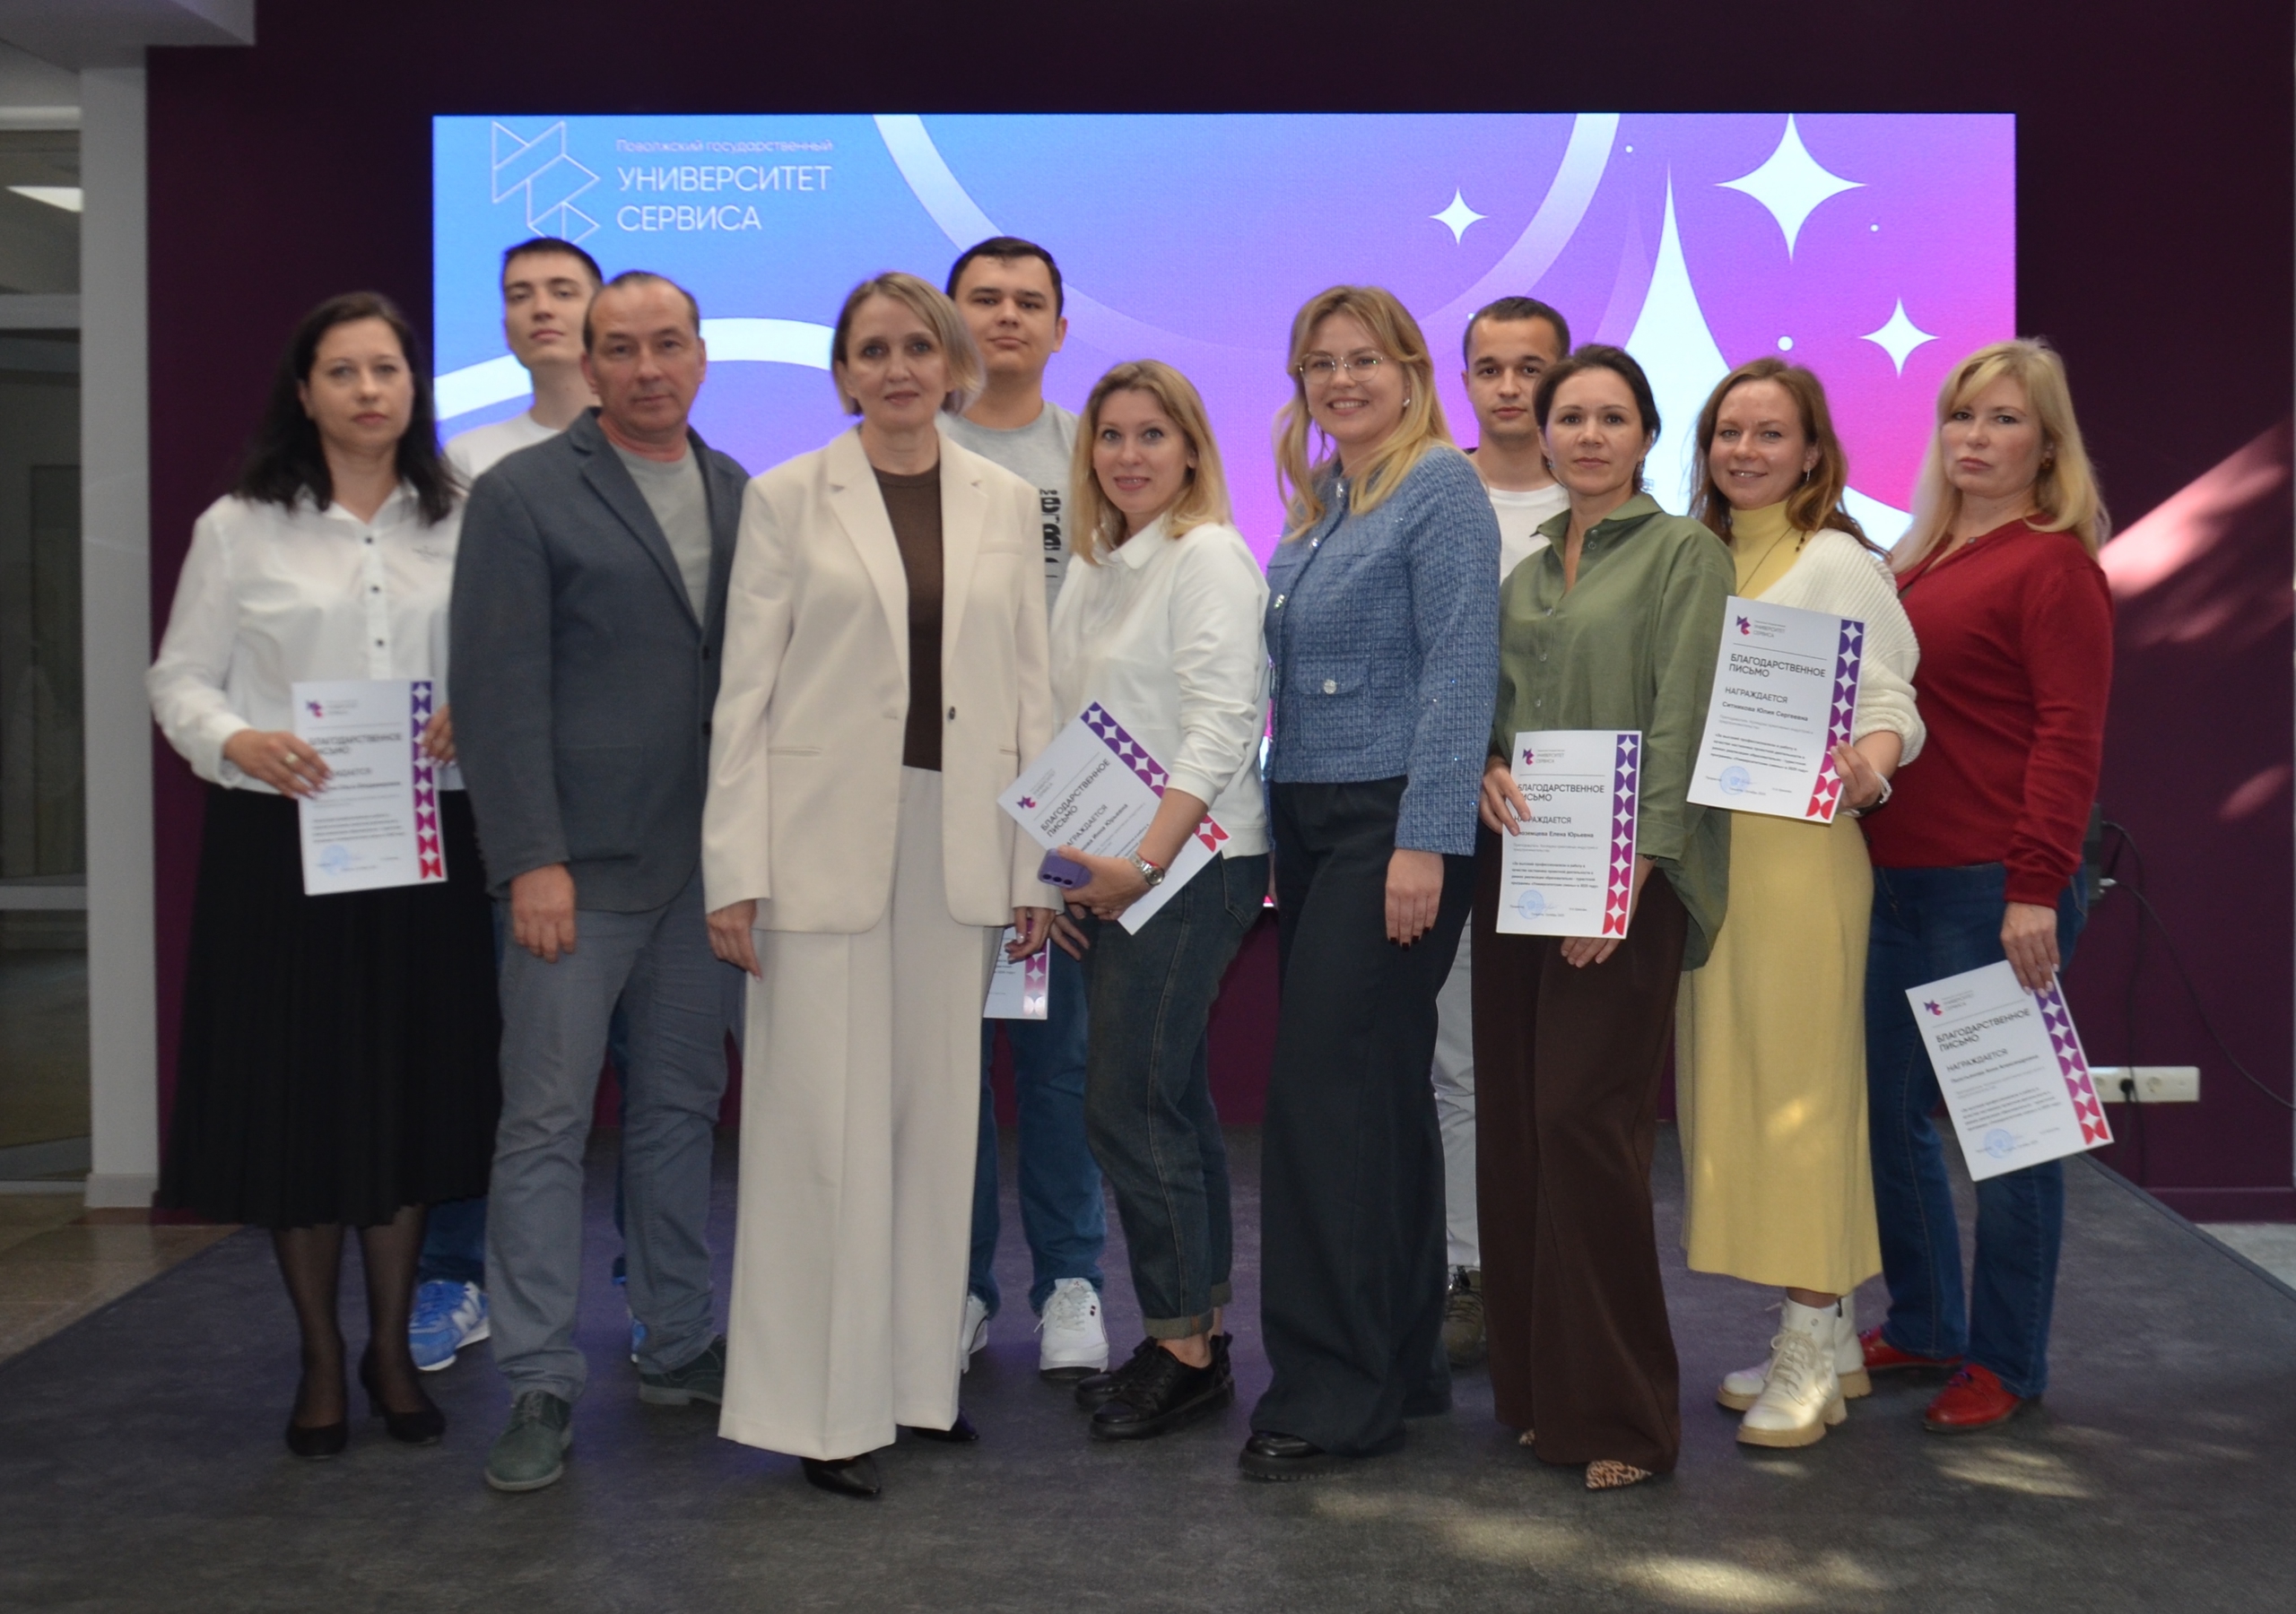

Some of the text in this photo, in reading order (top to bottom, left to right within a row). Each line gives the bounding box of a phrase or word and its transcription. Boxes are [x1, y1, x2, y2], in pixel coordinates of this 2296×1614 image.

[616, 139, 833, 153] Поволжский государственный
[617, 165, 832, 191] УНИВЕРСИТЕТ
[617, 205, 762, 231] СЕРВИСА
[1729, 664, 1770, 678] ПИСЬМО
[1730, 654, 1826, 678] БЛАГОДАРСТВЕННОЕ
[1725, 687, 1788, 704] НАГРАЖДАЕТСЯ
[1757, 707, 1775, 716] Юлия
[1776, 711, 1808, 722] Сергеевна
[1040, 759, 1111, 832] БЛАГОДАРСТВЕННОЕ
[1518, 784, 1605, 794] БЛАГОДАРСТВЕННОЕ
[1047, 805, 1078, 837] ПИСЬМО
[1066, 804, 1108, 846] АГРАЖДАЕТСЯ
[1935, 1008, 2031, 1045] БЛАГОДАРСТВЕННОЕ
[1939, 1034, 1980, 1053] ПИСЬМО
[1946, 1048, 2008, 1072] НАГРАЖДАЕТСЯ
